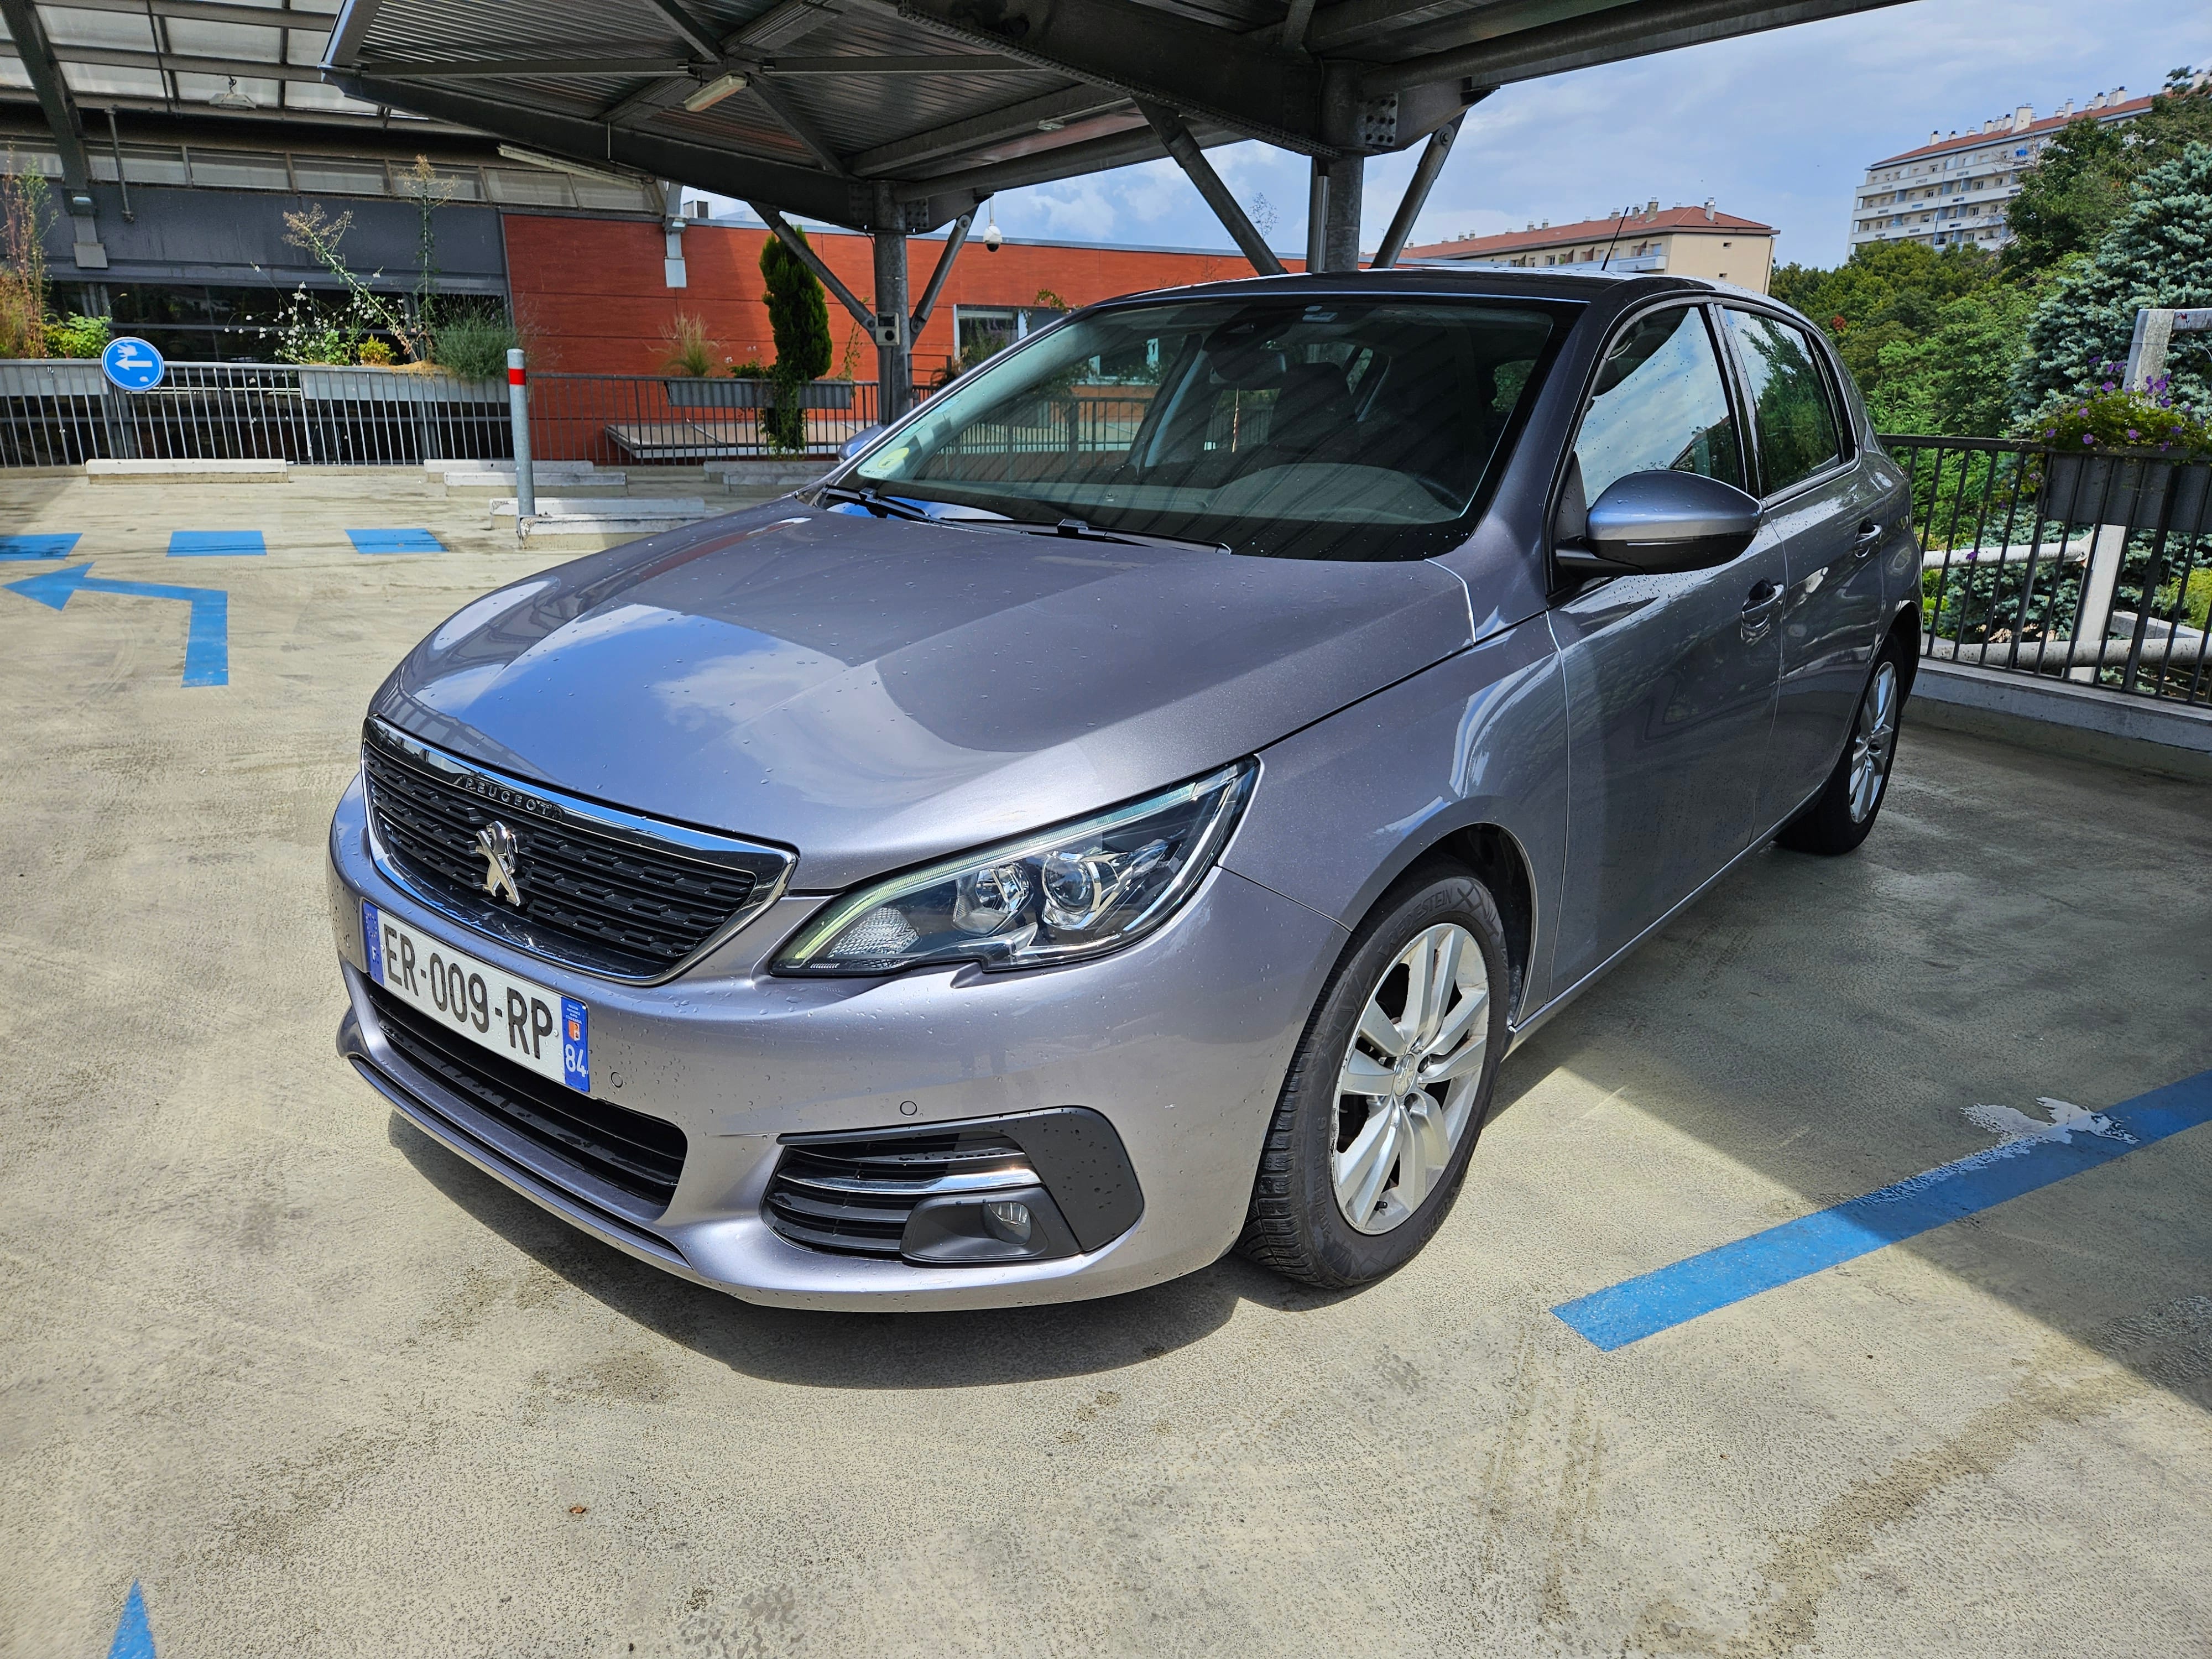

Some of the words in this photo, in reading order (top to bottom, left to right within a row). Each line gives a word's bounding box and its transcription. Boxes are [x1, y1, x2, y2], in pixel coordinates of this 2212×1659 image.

[465, 777, 552, 815] PEUGEOT
[1377, 887, 1453, 956] VREDESTEIN
[372, 946, 377, 961] F
[384, 924, 552, 1060] ER-009-RP
[565, 1043, 587, 1078] 84
